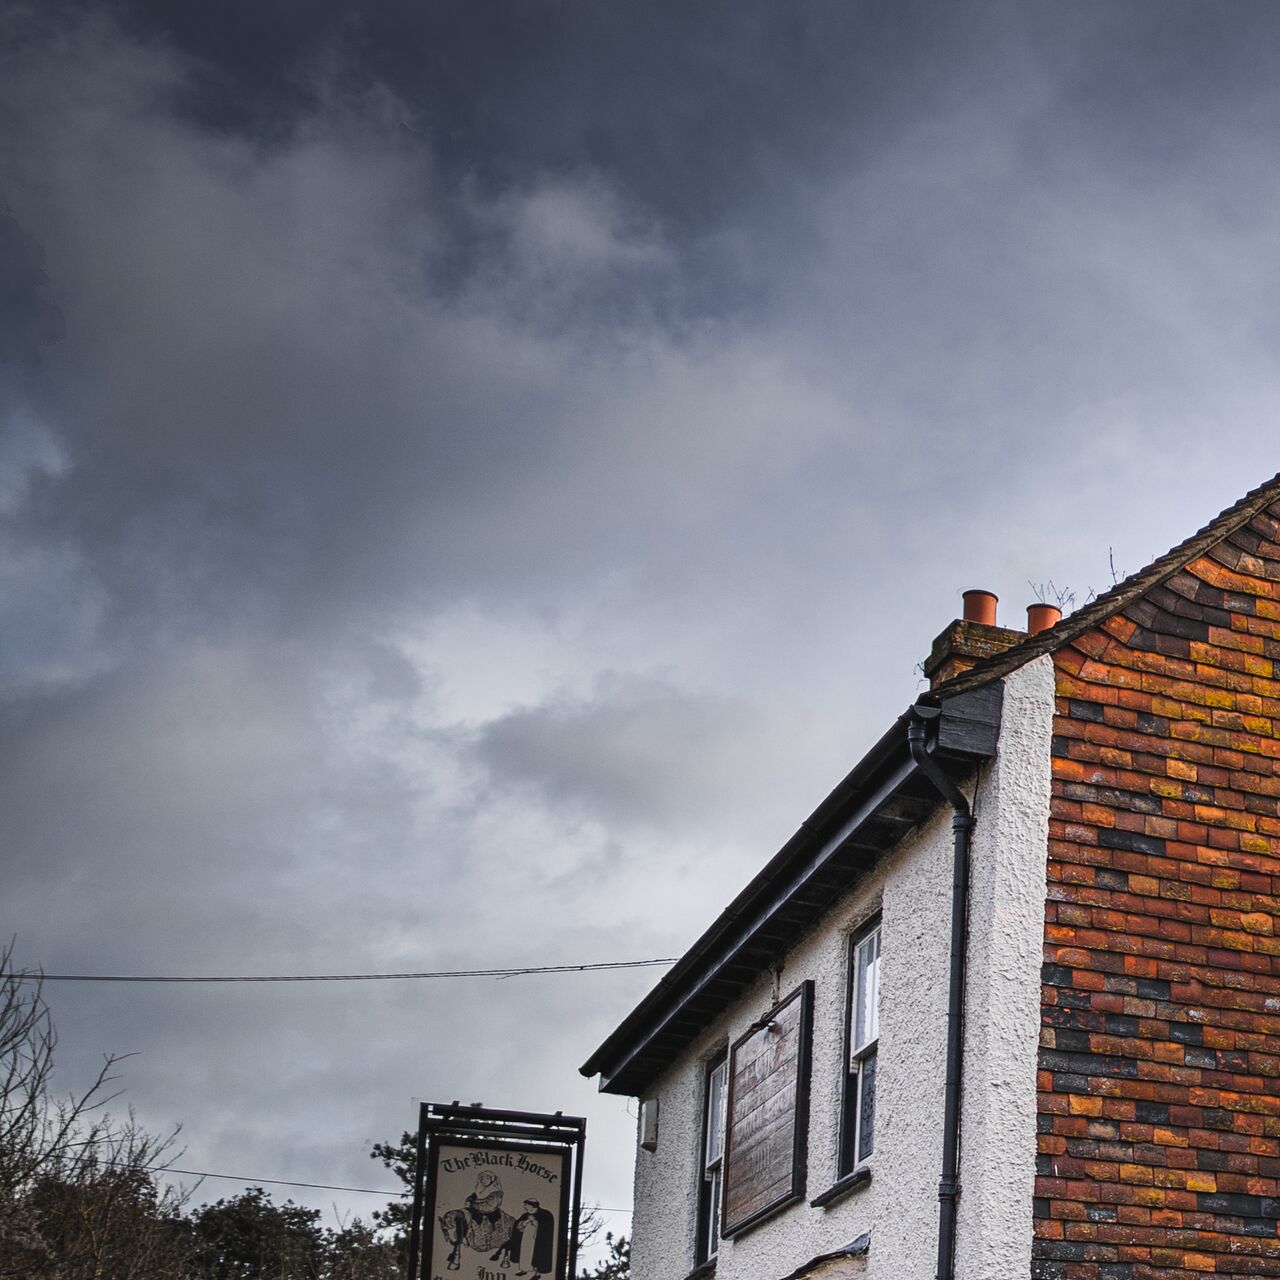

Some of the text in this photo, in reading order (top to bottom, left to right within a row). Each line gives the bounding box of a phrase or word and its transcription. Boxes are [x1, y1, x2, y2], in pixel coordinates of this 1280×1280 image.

[440, 1152, 558, 1183] The Black Horse
